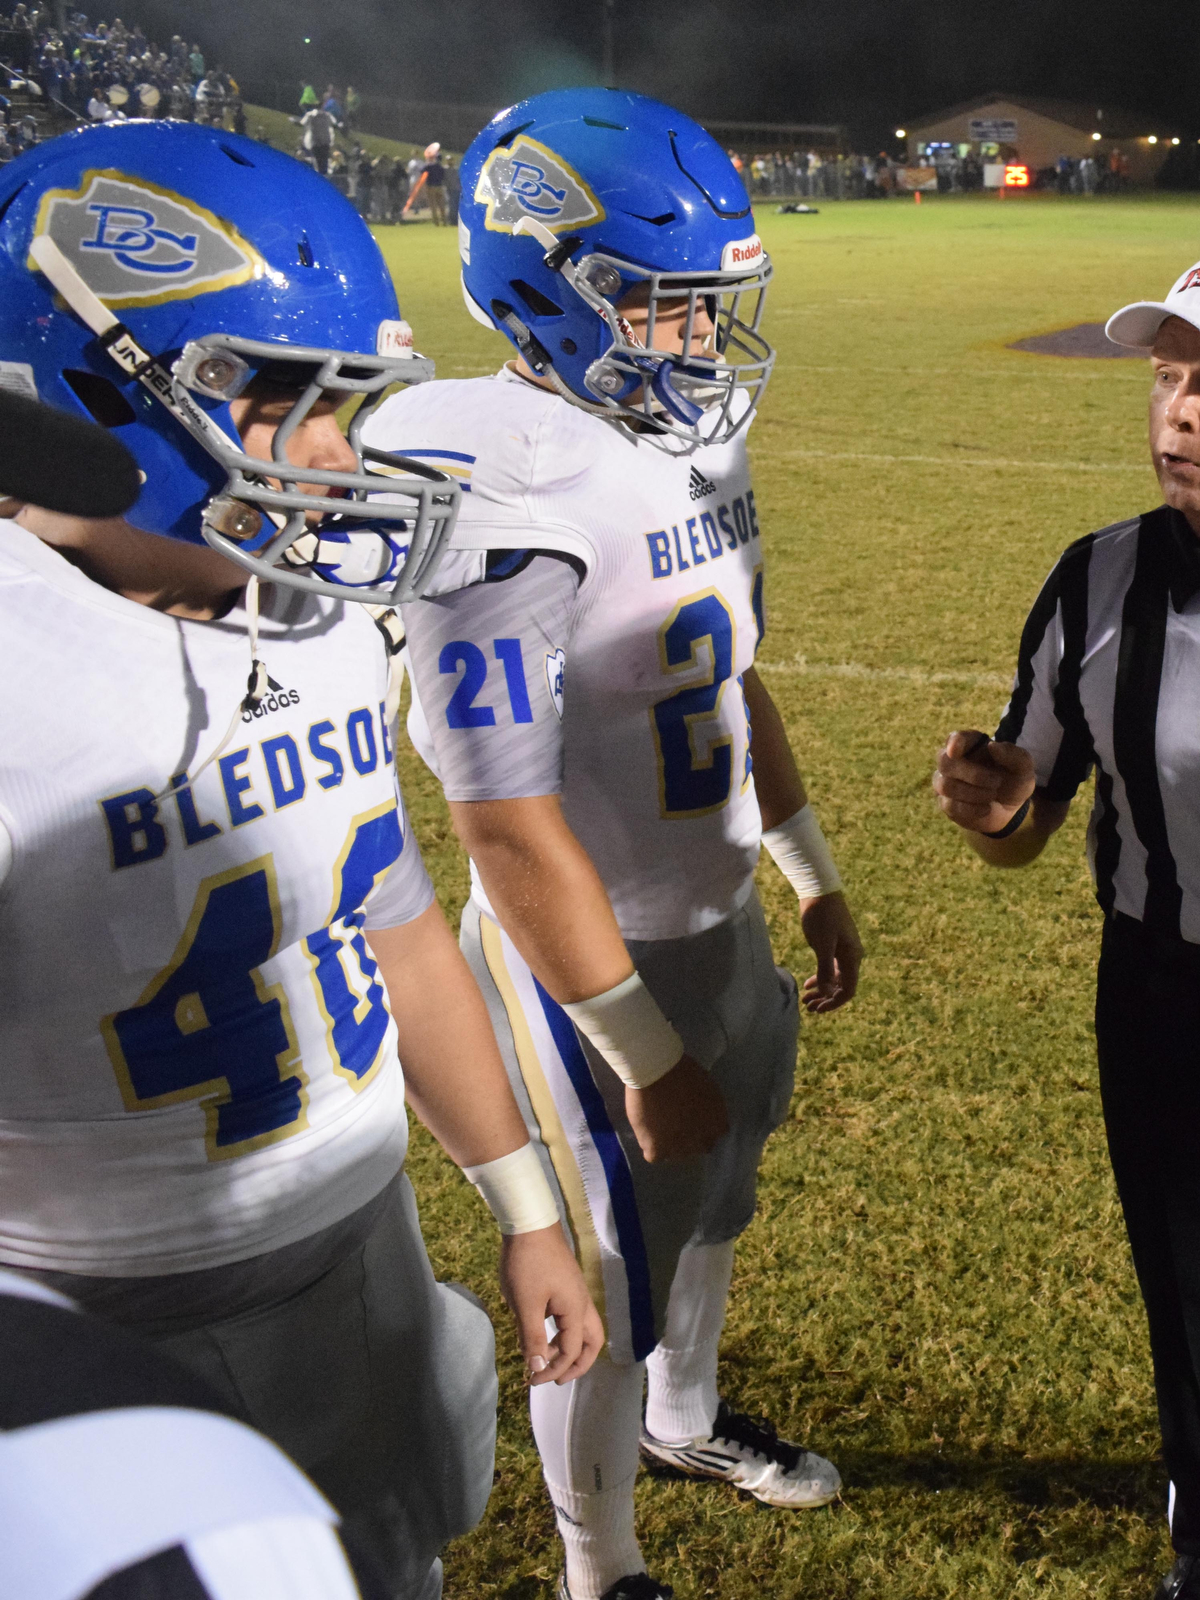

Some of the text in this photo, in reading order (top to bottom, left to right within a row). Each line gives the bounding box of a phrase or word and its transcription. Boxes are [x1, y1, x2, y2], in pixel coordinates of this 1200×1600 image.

[502, 160, 568, 218] BC
[1004, 165, 1029, 187] 25
[80, 202, 198, 275] BC
[689, 480, 717, 501] adidas
[643, 488, 760, 581] BLEDSOE
[438, 638, 534, 729] 21
[100, 796, 404, 1163] 40
